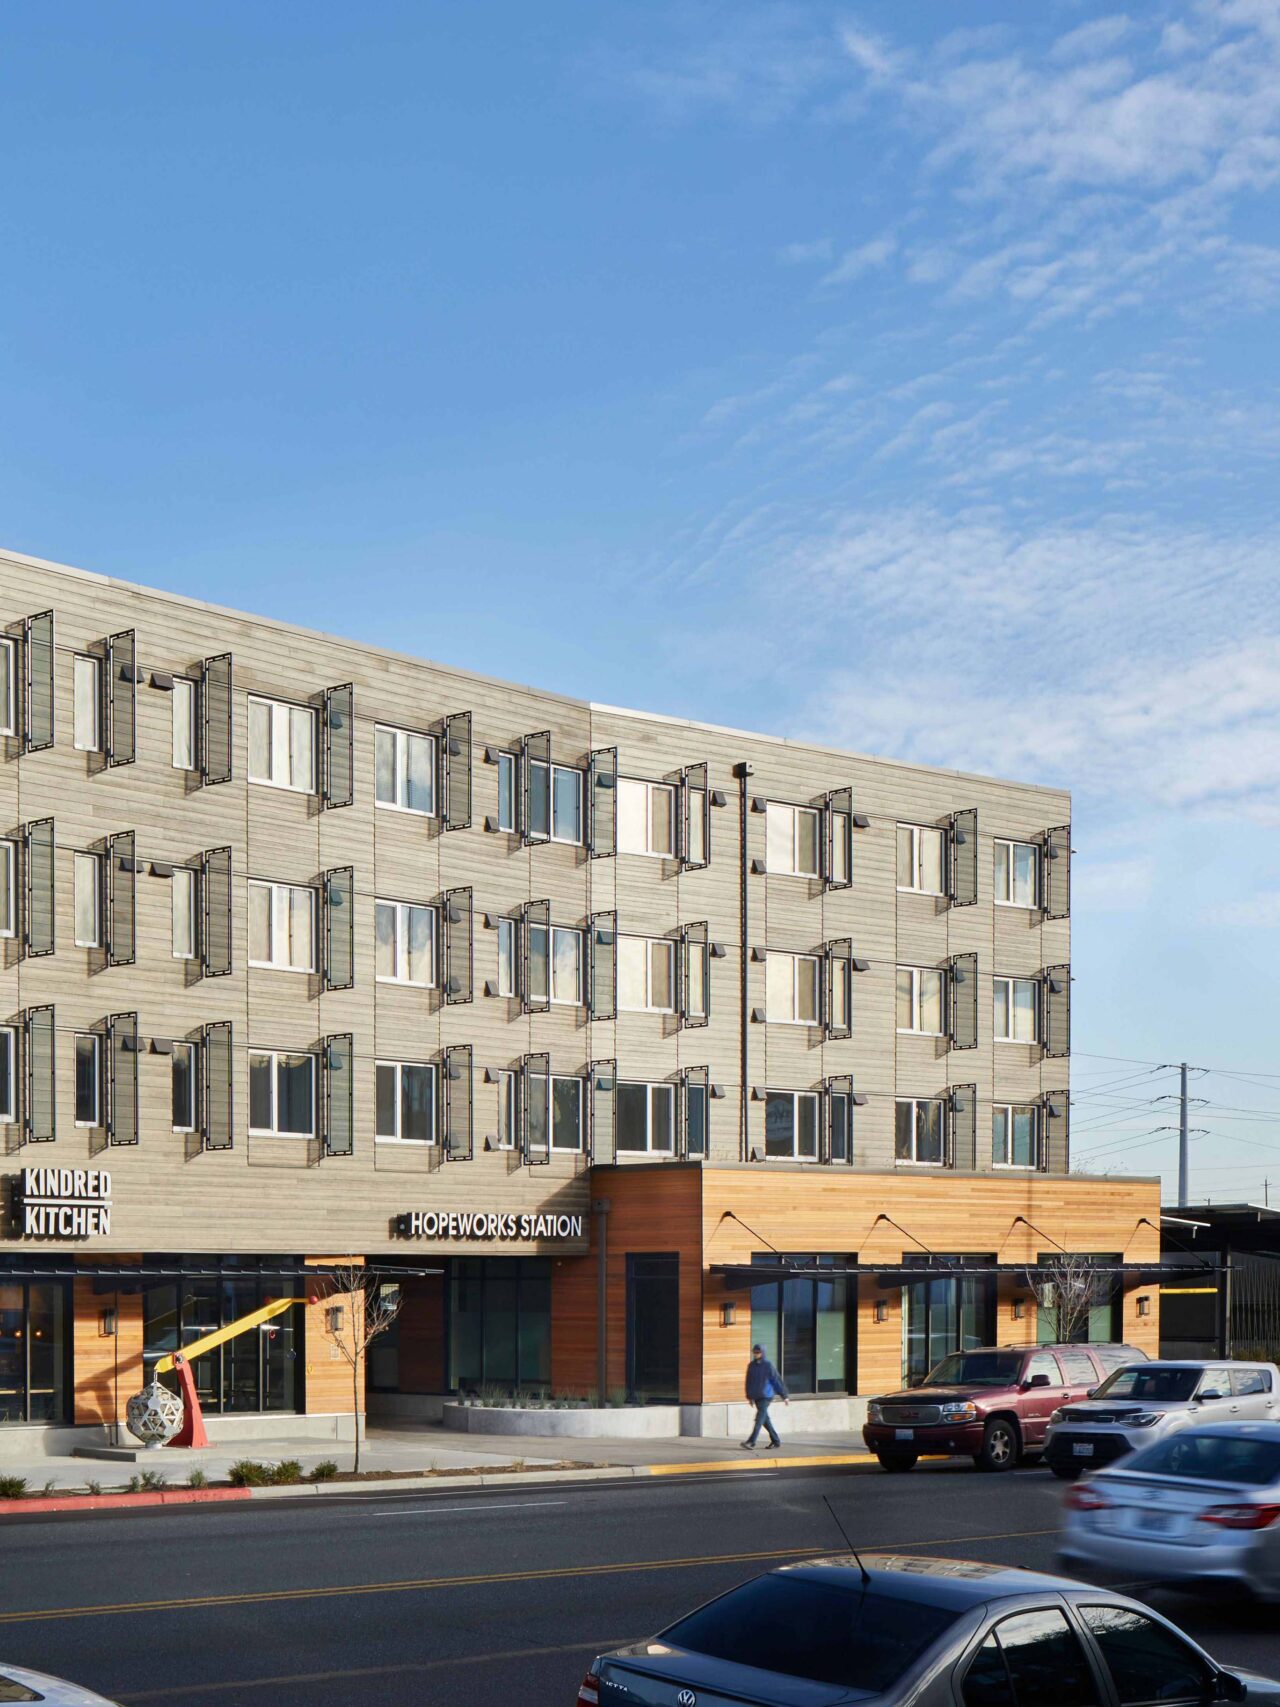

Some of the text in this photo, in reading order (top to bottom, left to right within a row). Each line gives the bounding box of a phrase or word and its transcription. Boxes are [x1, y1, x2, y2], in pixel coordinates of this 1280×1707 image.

[25, 1168, 112, 1197] KINDRED
[25, 1206, 111, 1235] KITCHEN
[411, 1212, 582, 1237] HOPEWORKS STATION
